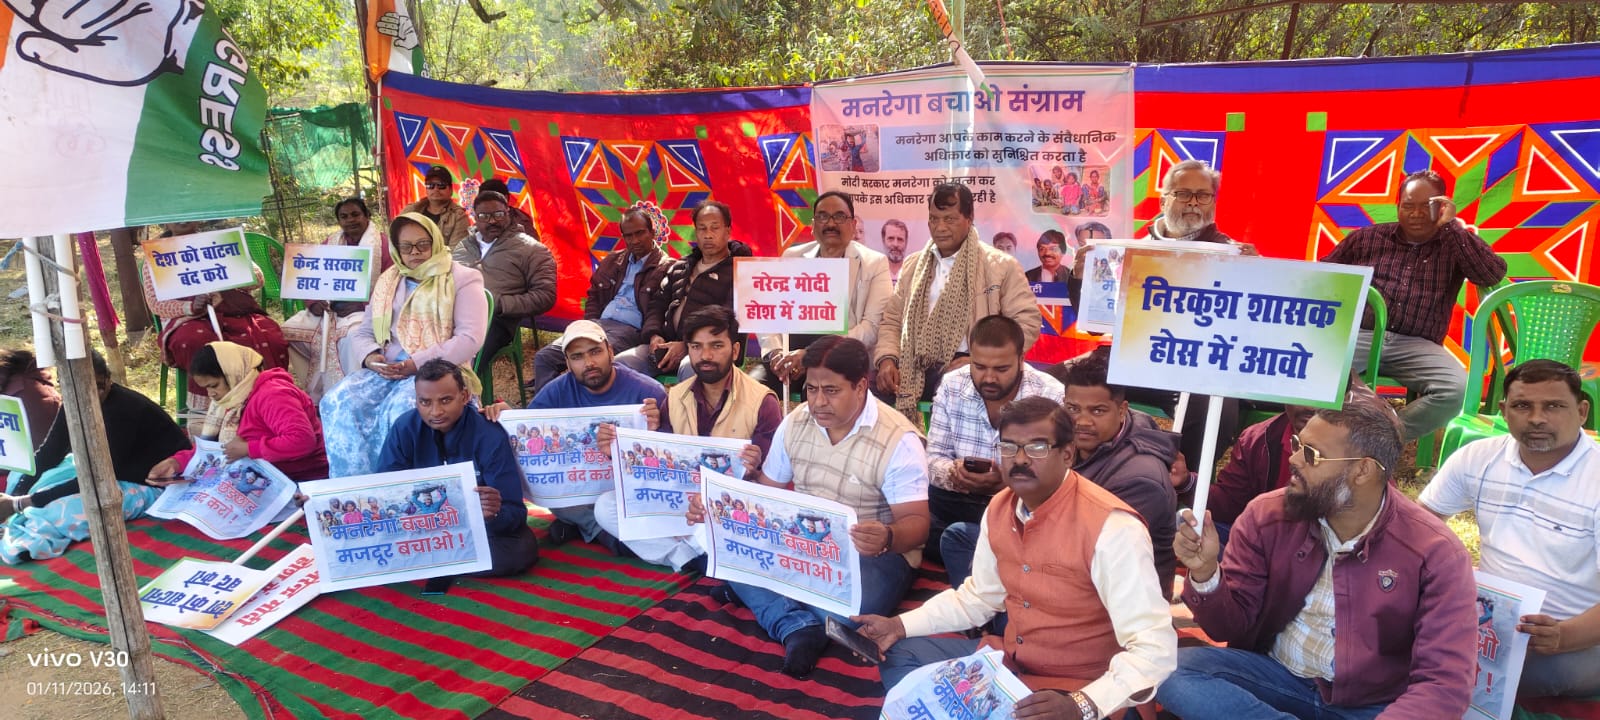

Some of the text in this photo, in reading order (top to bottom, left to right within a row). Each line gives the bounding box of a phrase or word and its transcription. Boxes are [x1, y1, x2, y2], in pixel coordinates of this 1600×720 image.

[841, 83, 1085, 117] मनरेगा बचाओ संग्राम
[895, 132, 936, 144] मनरेगा
[976, 131, 1003, 142] काम
[1004, 130, 1034, 143] करने
[1037, 130, 1050, 143] के
[1052, 130, 1117, 144] संवैधानिक
[925, 147, 1088, 163] अधिकार को सुनिश्चित करता है
[841, 176, 860, 187] मोदी
[862, 178, 889, 188] सरकार
[892, 176, 929, 188] मनरेगा
[978, 176, 995, 186] कर
[870, 194, 882, 204] इस
[885, 191, 924, 204] अधिकार
[990, 191, 997, 203] है
[152, 241, 240, 267] देश को बांटना
[292, 253, 364, 272] केन्द्र सरकार
[178, 263, 228, 286] बंद करो
[296, 277, 321, 290] हाय
[332, 278, 357, 291] हाय
[752, 272, 831, 292] नरेन्द्र मोदी
[745, 300, 837, 321] होश में आवो
[1142, 276, 1342, 328] निरकुंश शासक
[1149, 328, 1313, 379] होस में आवो
[518, 451, 566, 466] मनरेगा
[570, 449, 581, 463] से
[526, 471, 564, 484] करना
[567, 467, 586, 482] बंद
[632, 463, 688, 484] मनरेगा
[207, 496, 234, 519] करो
[634, 488, 683, 509] मजदूर
[329, 505, 459, 540] मनरेगा बचाओ
[336, 531, 465, 566] मजदूर बचाओ !
[720, 517, 840, 561] मनरेगा बचाओ
[724, 538, 843, 586] मजदूर बचाओ !
[184, 570, 242, 594] बंद करो
[140, 588, 186, 609] बांटना
[179, 594, 209, 613] को
[202, 600, 234, 619] देश
